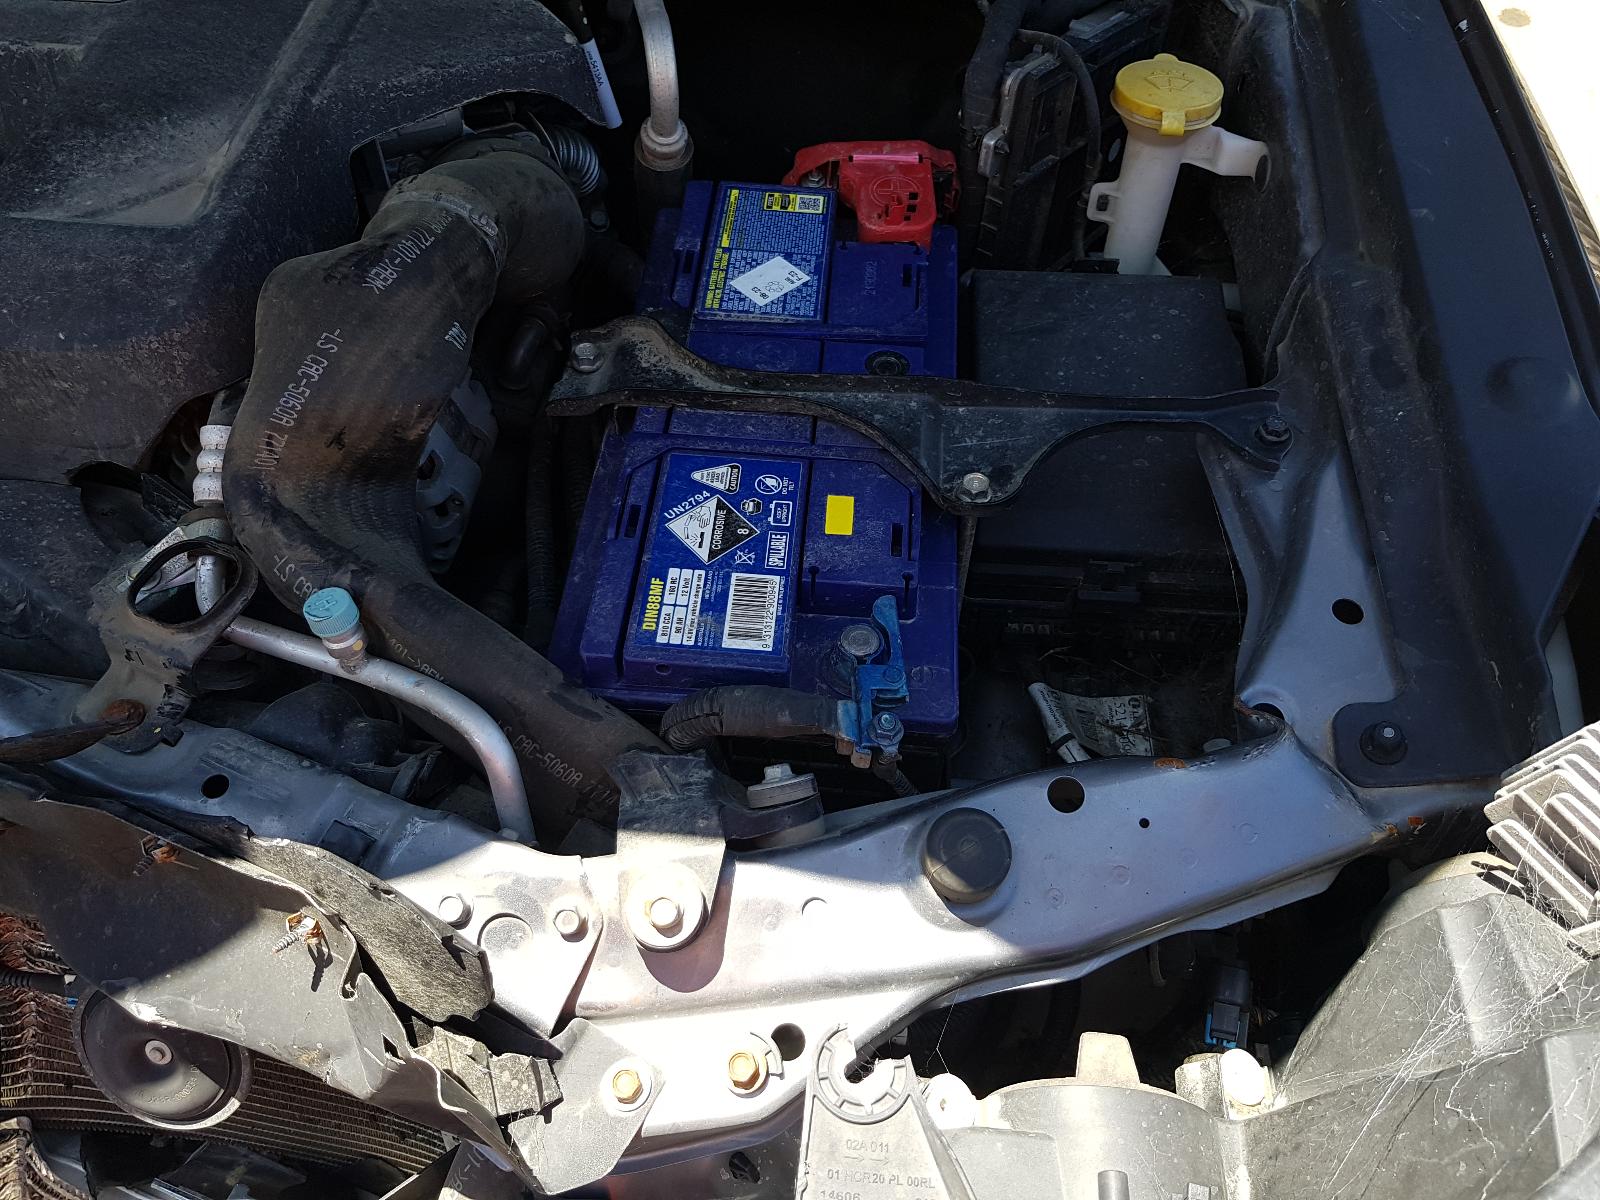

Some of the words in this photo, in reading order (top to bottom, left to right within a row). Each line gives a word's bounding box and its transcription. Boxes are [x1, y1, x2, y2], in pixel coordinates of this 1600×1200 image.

[270, 354, 328, 427] CAC-5060A
[729, 468, 739, 490] CAUTION
[782, 486, 788, 494] DO
[664, 490, 711, 519] UN2794
[712, 509, 727, 550] CORROSIVE
[768, 534, 786, 566] SPILLABLE
[642, 578, 664, 630] DIN88MF
[767, 580, 777, 608] 900945
[661, 626, 669, 636] 810
[663, 612, 671, 625] CCA
[676, 617, 684, 626] AH
[763, 610, 773, 639] 313122
[513, 734, 584, 788] CAC-5060A
[827, 1169, 839, 1180] 01
